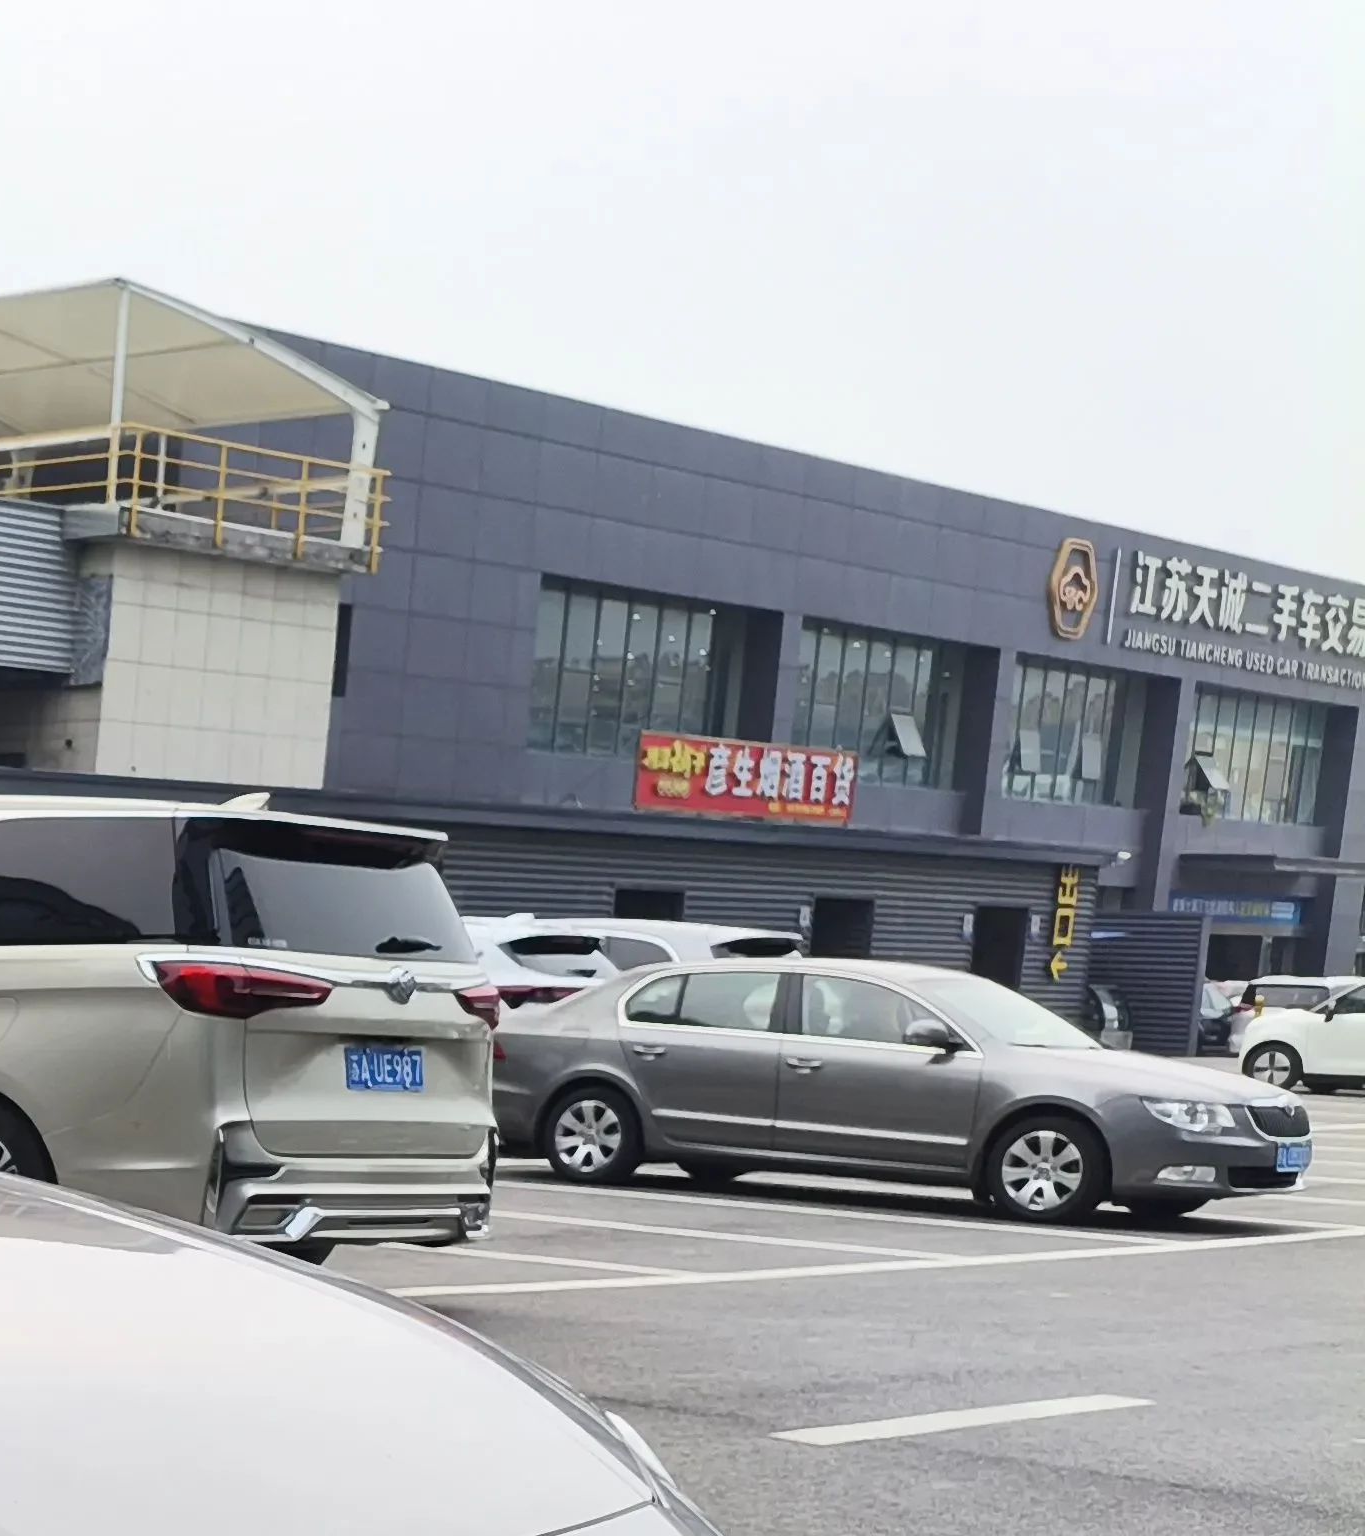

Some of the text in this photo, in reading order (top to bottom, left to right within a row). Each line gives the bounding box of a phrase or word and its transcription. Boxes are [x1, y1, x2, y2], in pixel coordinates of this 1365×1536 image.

[1125, 629, 1365, 690] JIANGSU TIANCHENG USED CAR TRANSACTIO
[1053, 864, 1078, 945] 出口
